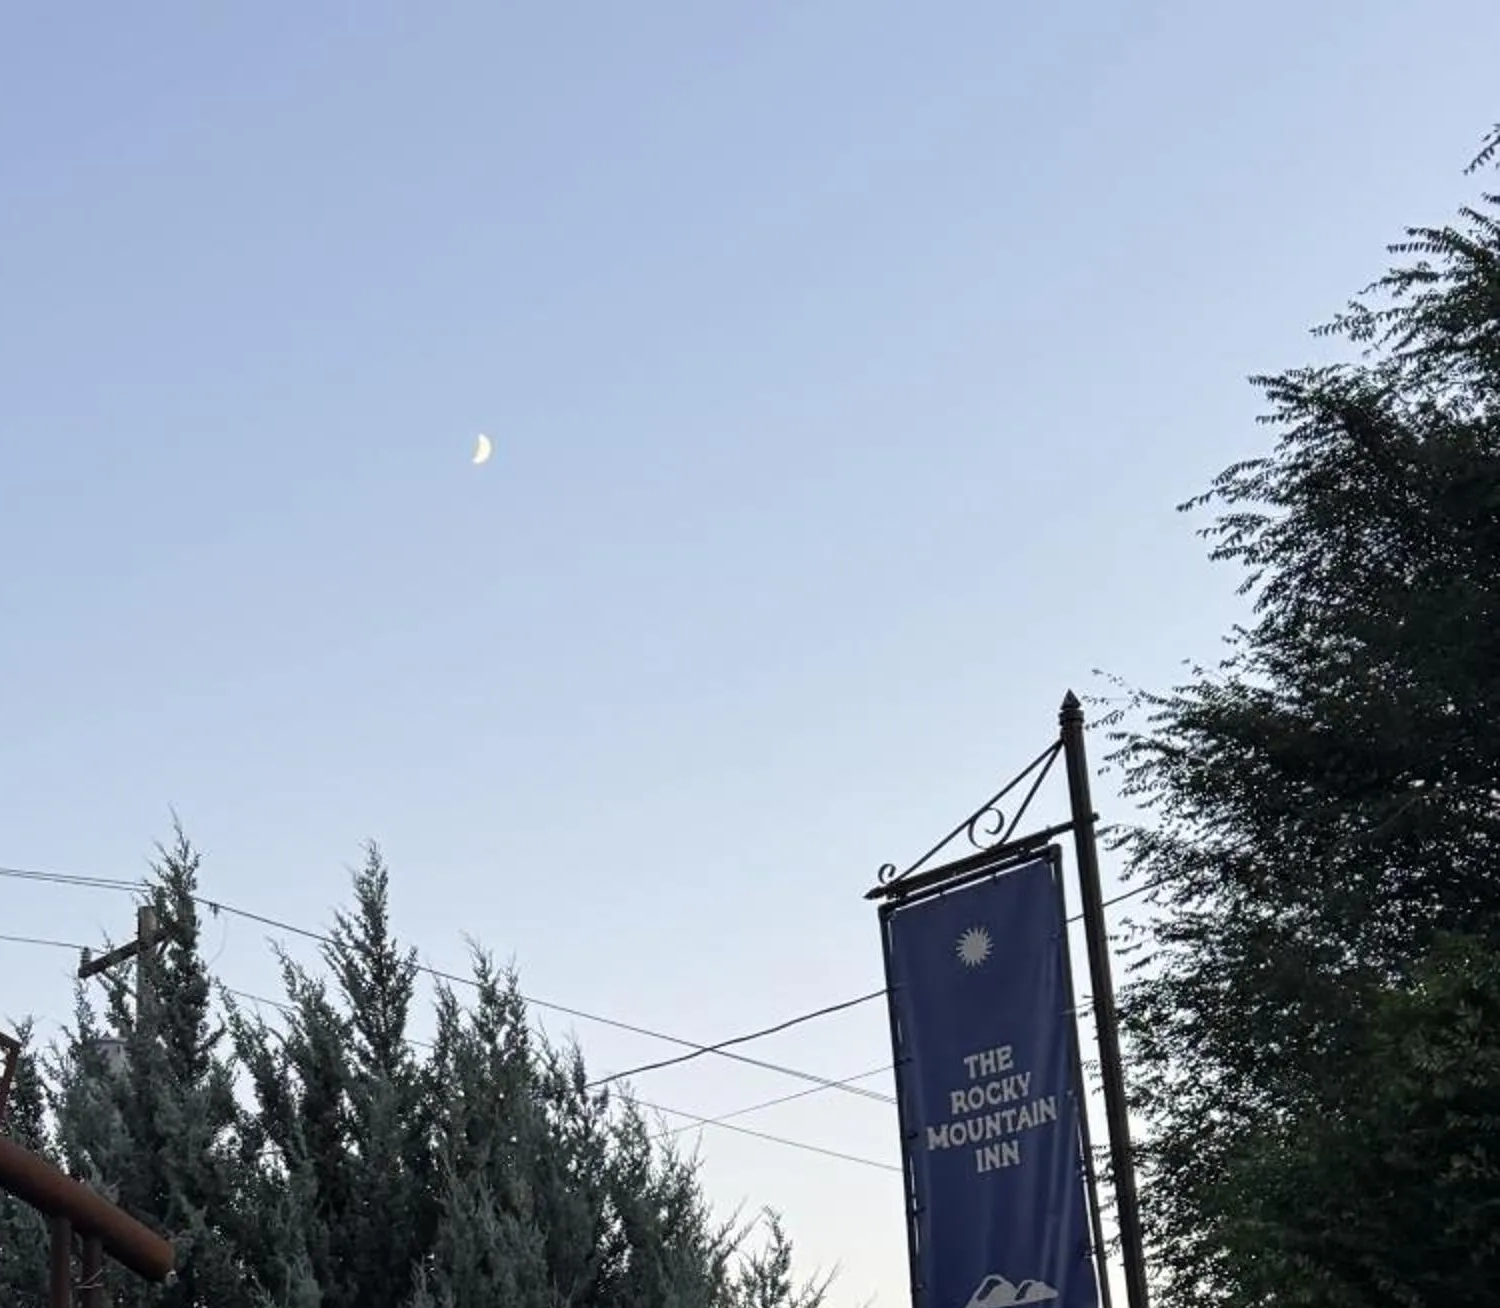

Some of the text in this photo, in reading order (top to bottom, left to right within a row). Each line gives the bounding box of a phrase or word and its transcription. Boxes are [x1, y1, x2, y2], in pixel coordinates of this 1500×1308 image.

[963, 1045, 1014, 1079] THE
[951, 1071, 1031, 1115] ROCKY
[926, 1096, 1057, 1150] MOUNTAIN
[975, 1140, 1021, 1173] INN
